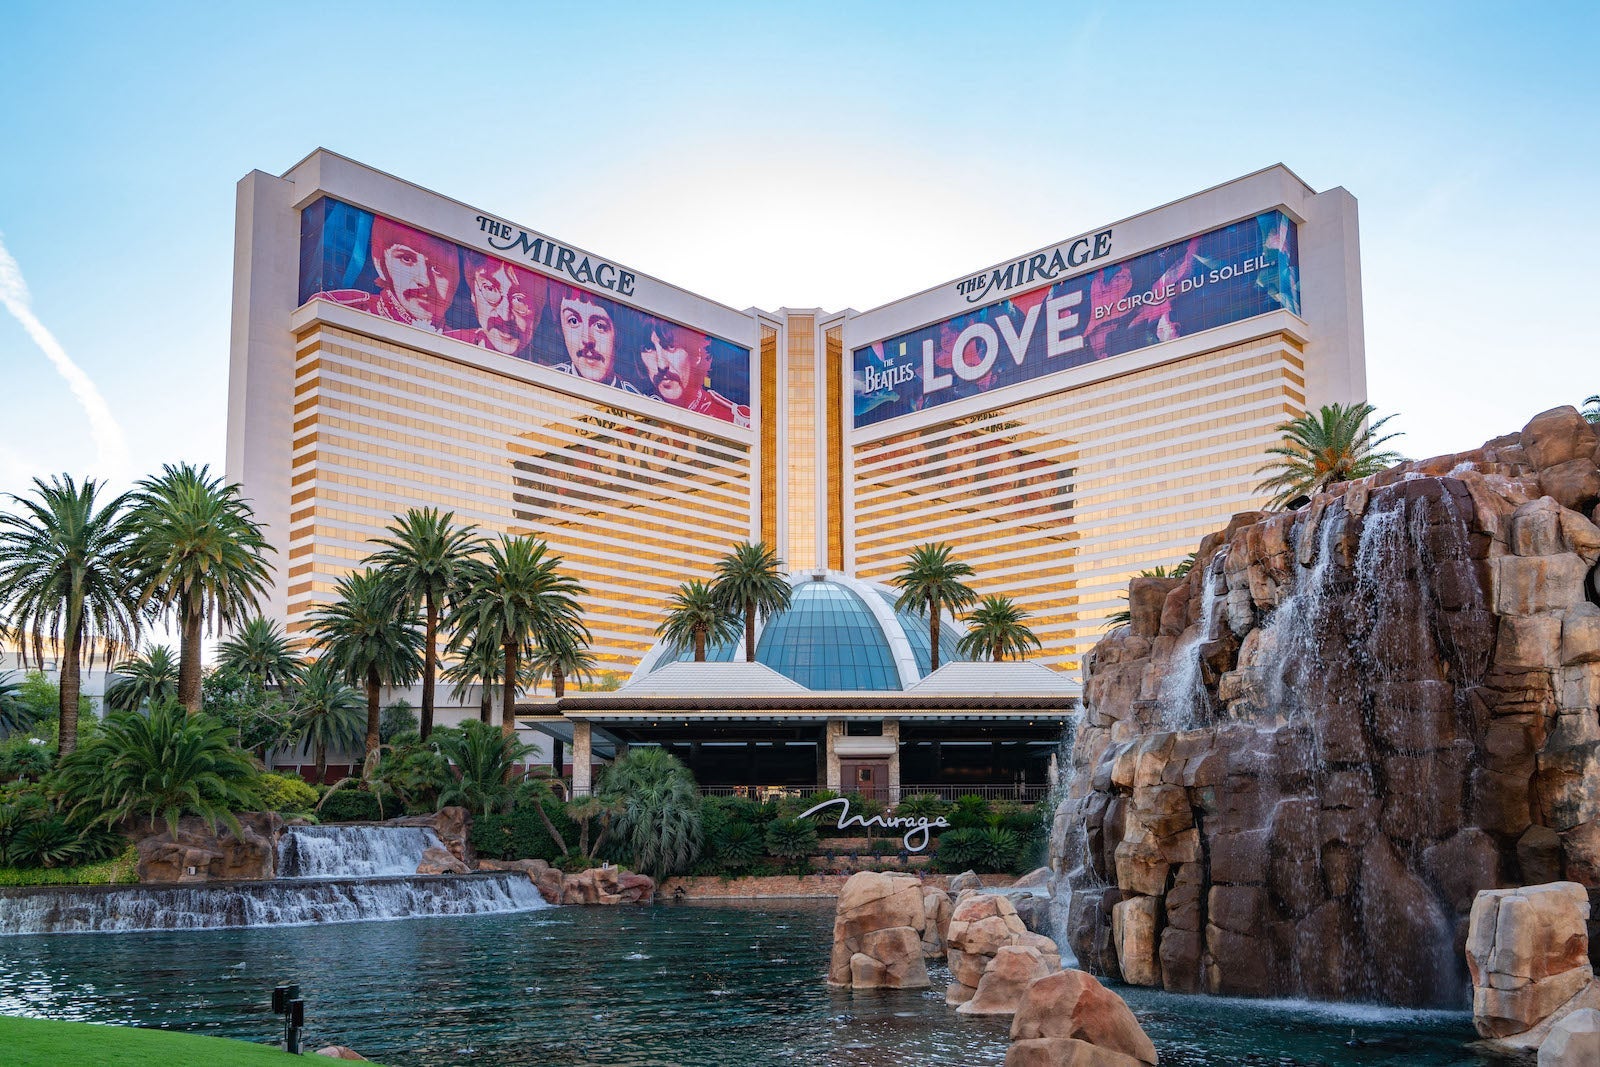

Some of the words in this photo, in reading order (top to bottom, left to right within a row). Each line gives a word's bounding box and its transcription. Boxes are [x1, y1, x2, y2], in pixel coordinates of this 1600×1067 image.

[476, 216, 512, 240] THE
[488, 231, 635, 297] MIRAGE
[966, 229, 1112, 302] MIRAGE
[956, 274, 987, 296] THE
[1095, 302, 1114, 320] BY
[1116, 283, 1176, 313] CIRQUE
[1181, 274, 1205, 293] DU
[922, 290, 1084, 395] LOVE
[864, 362, 915, 394] BEATLES
[883, 358, 894, 368] THE
